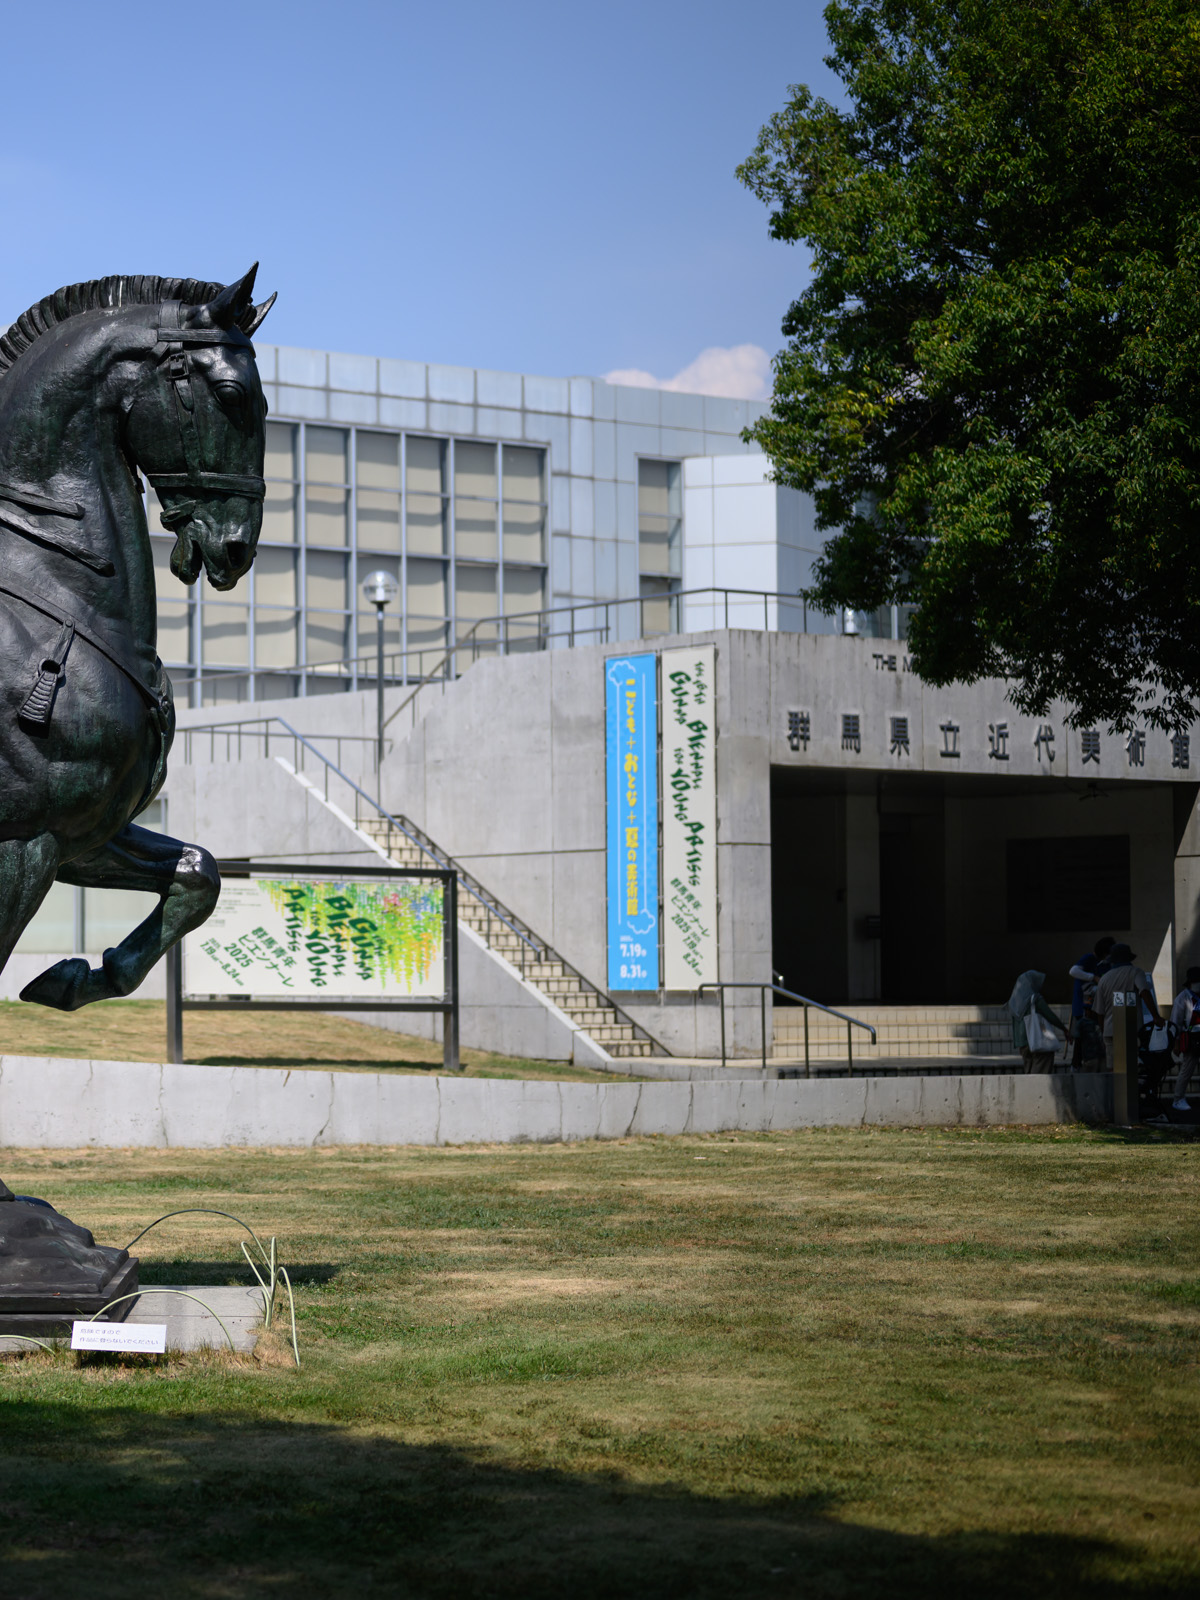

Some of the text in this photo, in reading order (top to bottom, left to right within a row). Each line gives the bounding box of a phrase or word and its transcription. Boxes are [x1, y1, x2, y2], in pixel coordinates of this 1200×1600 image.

[872, 653, 897, 671] THE
[669, 671, 691, 725] GUNMA
[686, 720, 708, 789] BIENNALE
[787, 711, 1190, 769] 群馬県立近代美術館
[670, 767, 691, 821] YOUNG
[683, 821, 705, 886] ARTISTS
[281, 889, 306, 952] ARTISTS
[324, 895, 354, 976] BIENNALE
[671, 895, 710, 937] ビエンナーレ
[671, 914, 691, 933] 2025
[224, 942, 254, 968] 2025
[238, 933, 295, 987] ビエンナーレ
[251, 926, 297, 968] 群馬青年
[304, 929, 330, 987] YOUNG
[348, 917, 379, 981] GUNMA
